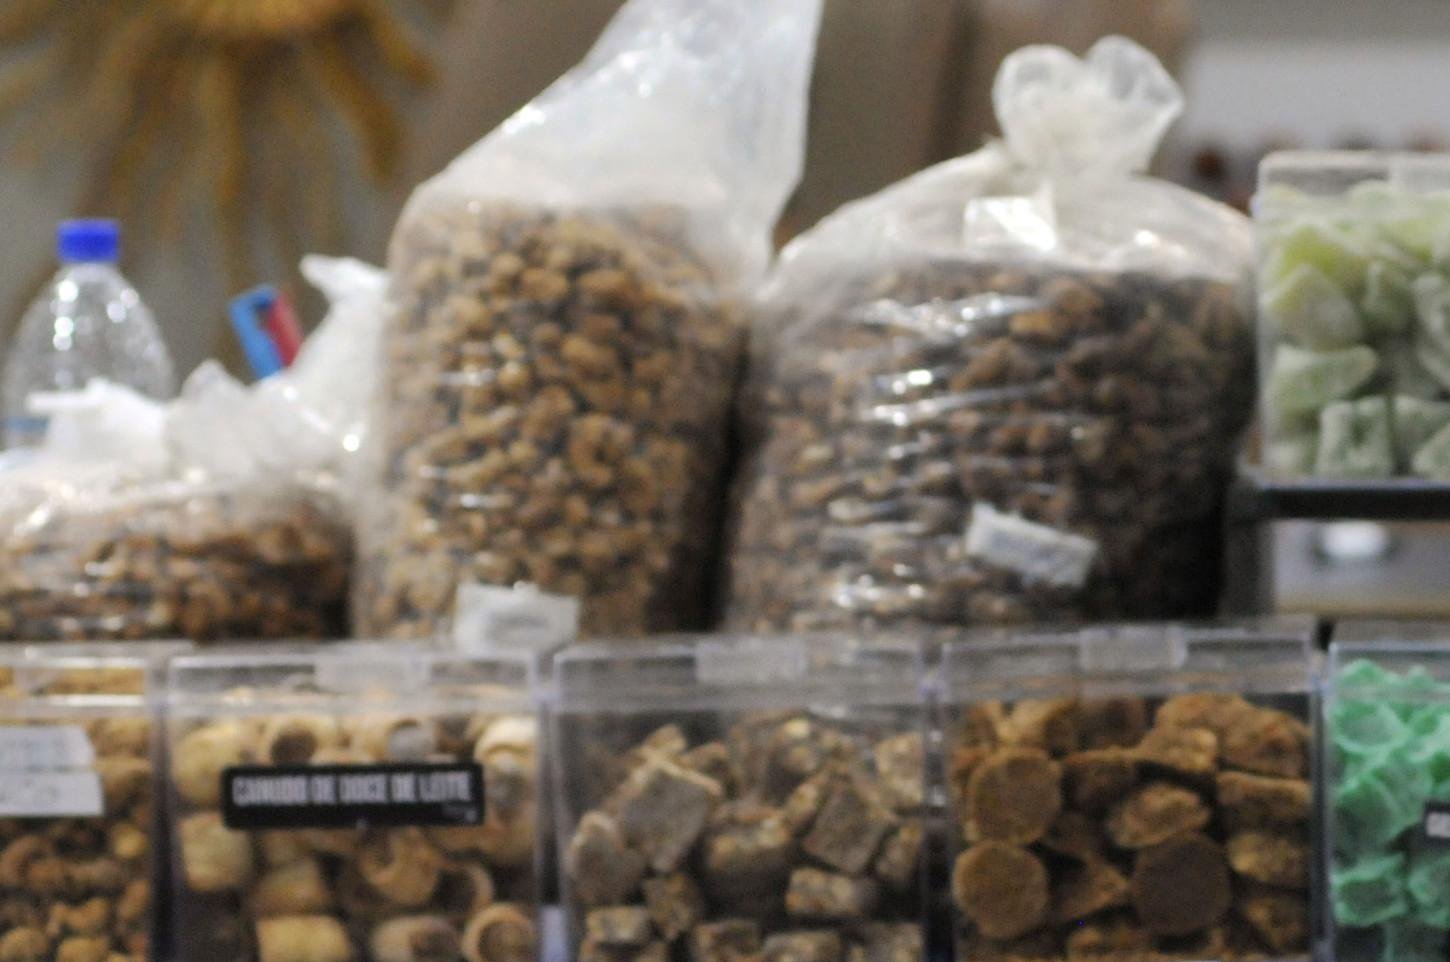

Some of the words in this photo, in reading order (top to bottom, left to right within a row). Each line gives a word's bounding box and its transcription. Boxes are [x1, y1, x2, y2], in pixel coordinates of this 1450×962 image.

[310, 774, 337, 804] DE
[339, 773, 388, 804] DOCE
[391, 772, 416, 803] DE
[418, 769, 471, 802] LEITE
